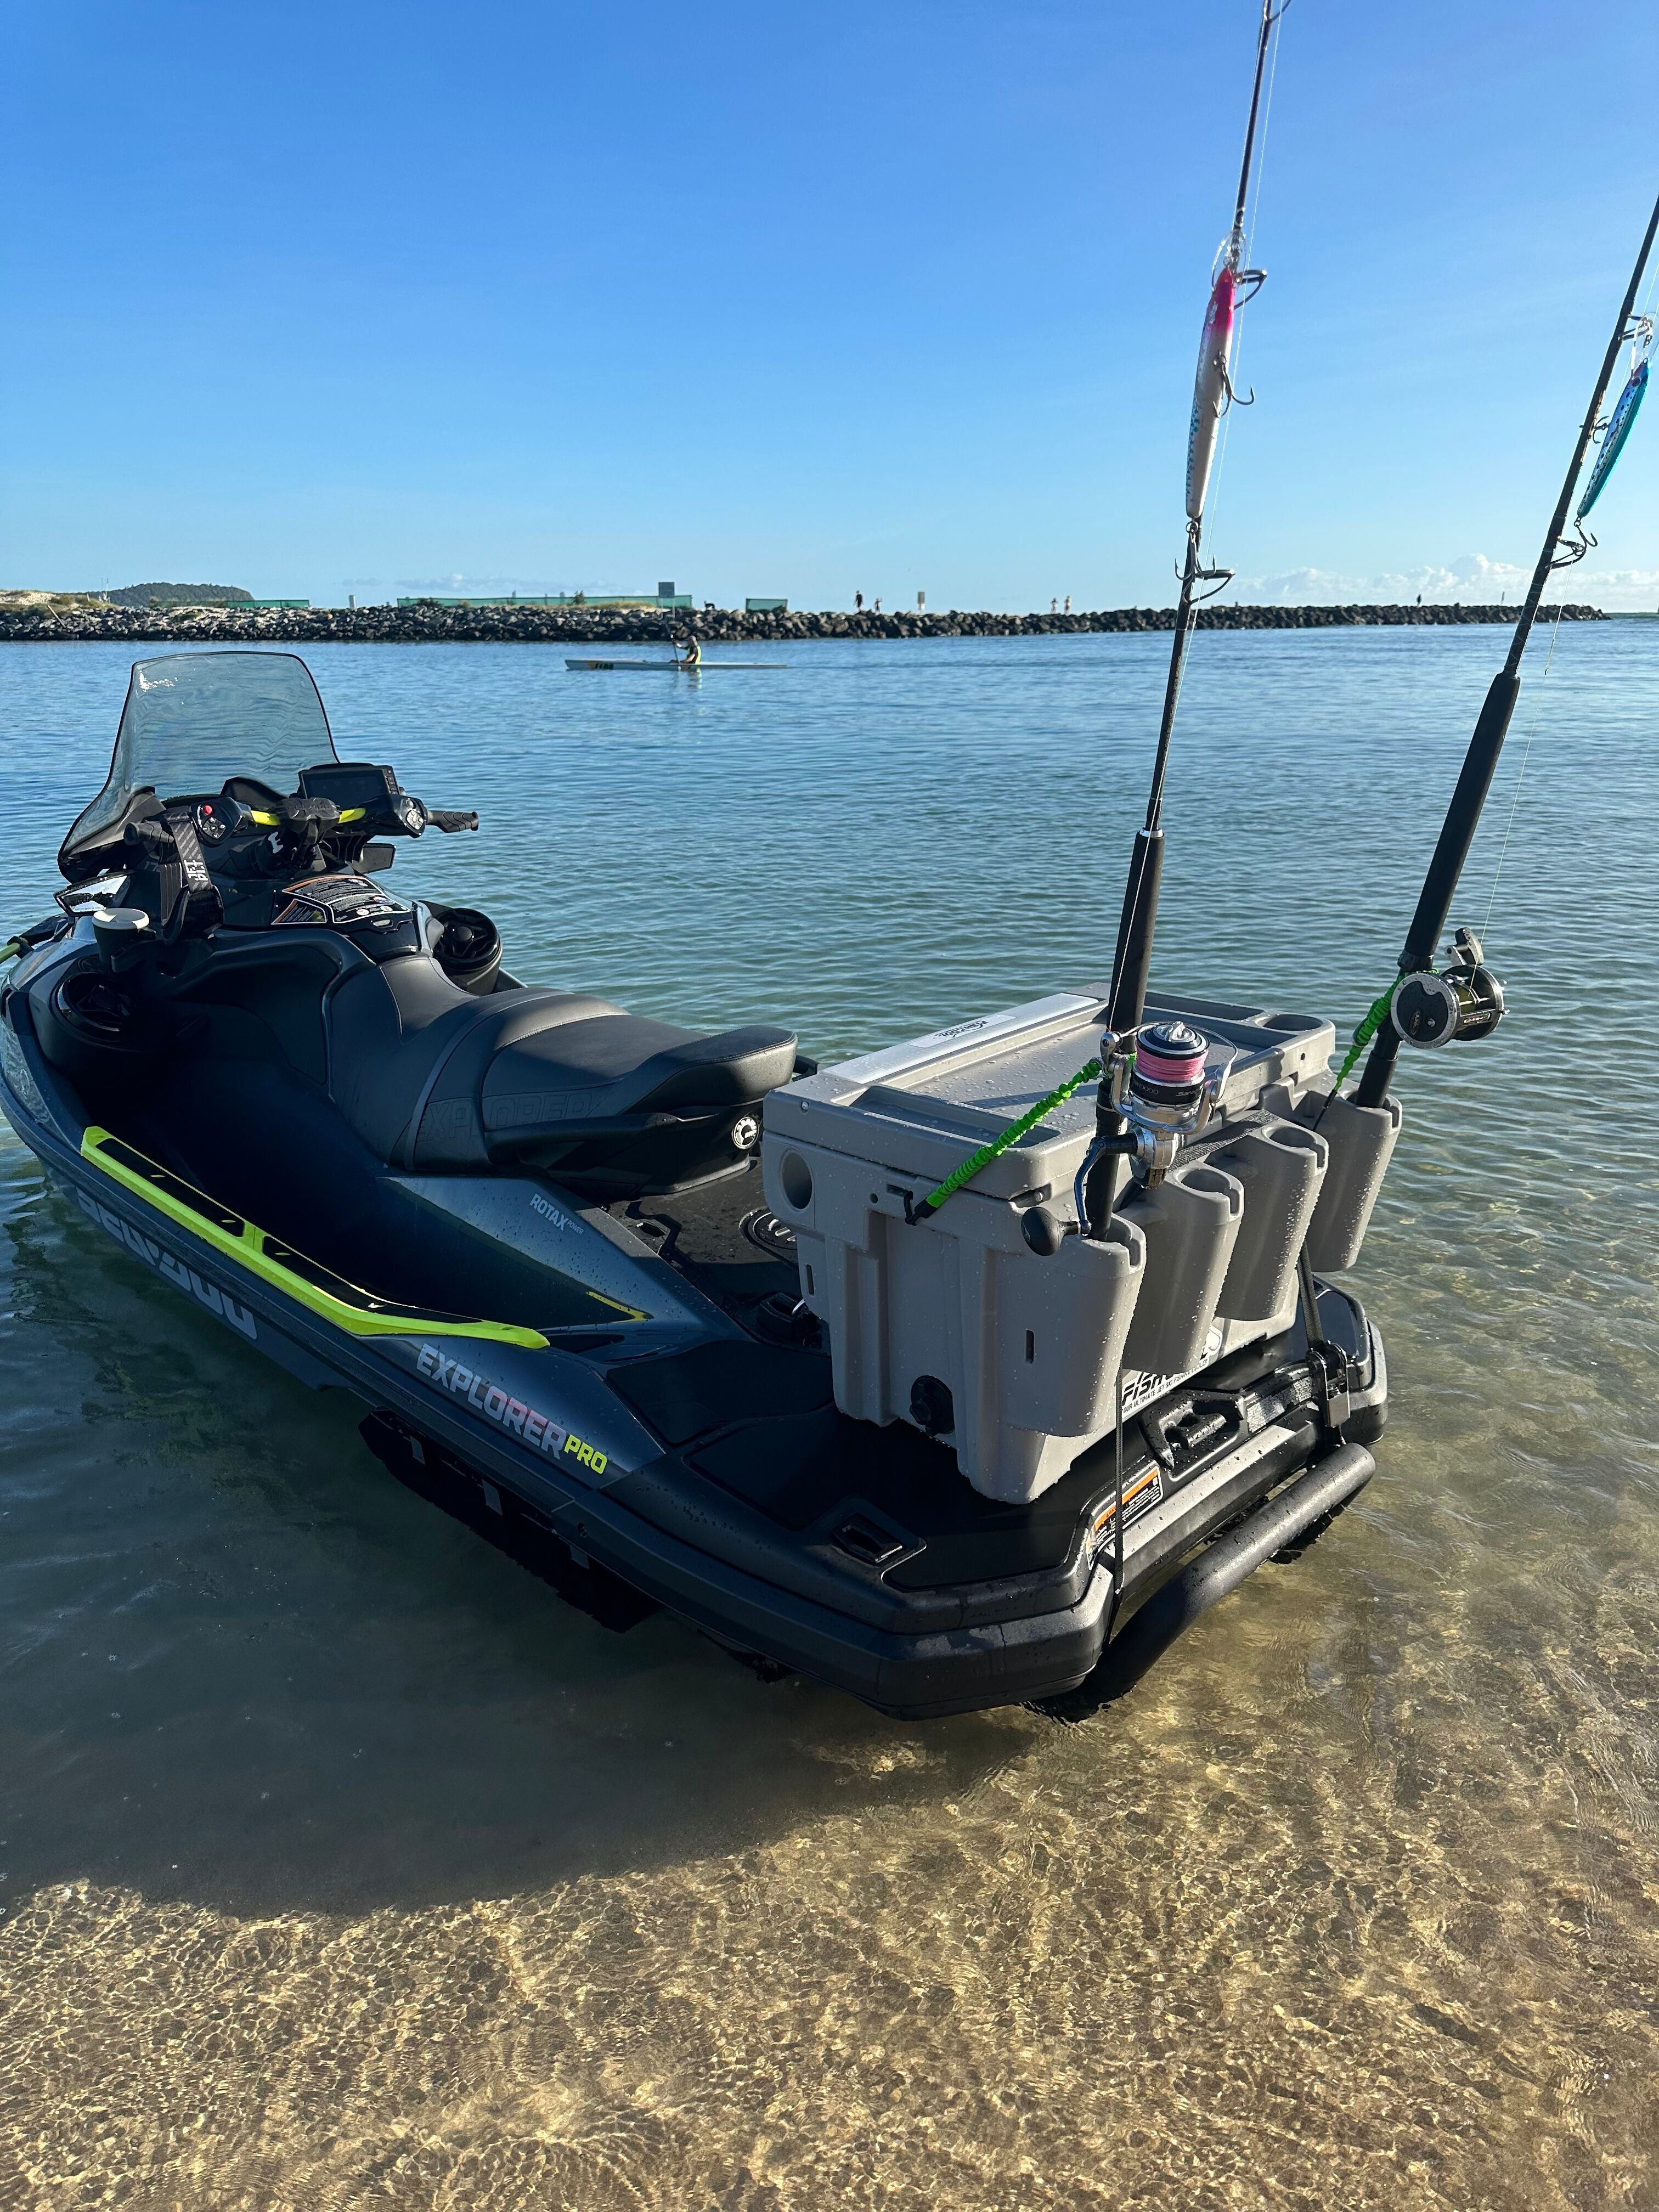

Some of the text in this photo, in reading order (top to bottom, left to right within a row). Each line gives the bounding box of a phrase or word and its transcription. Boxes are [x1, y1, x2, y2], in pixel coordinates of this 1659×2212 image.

[184, 860, 199, 881] JET
[529, 1193, 584, 1235] ROTAX POWER
[416, 1343, 608, 1475] EXPLORER PRO
[1122, 1403, 1132, 1413] OUR
[1134, 1390, 1155, 1407] ULTIMATE
[1156, 1385, 1165, 1393] JET
